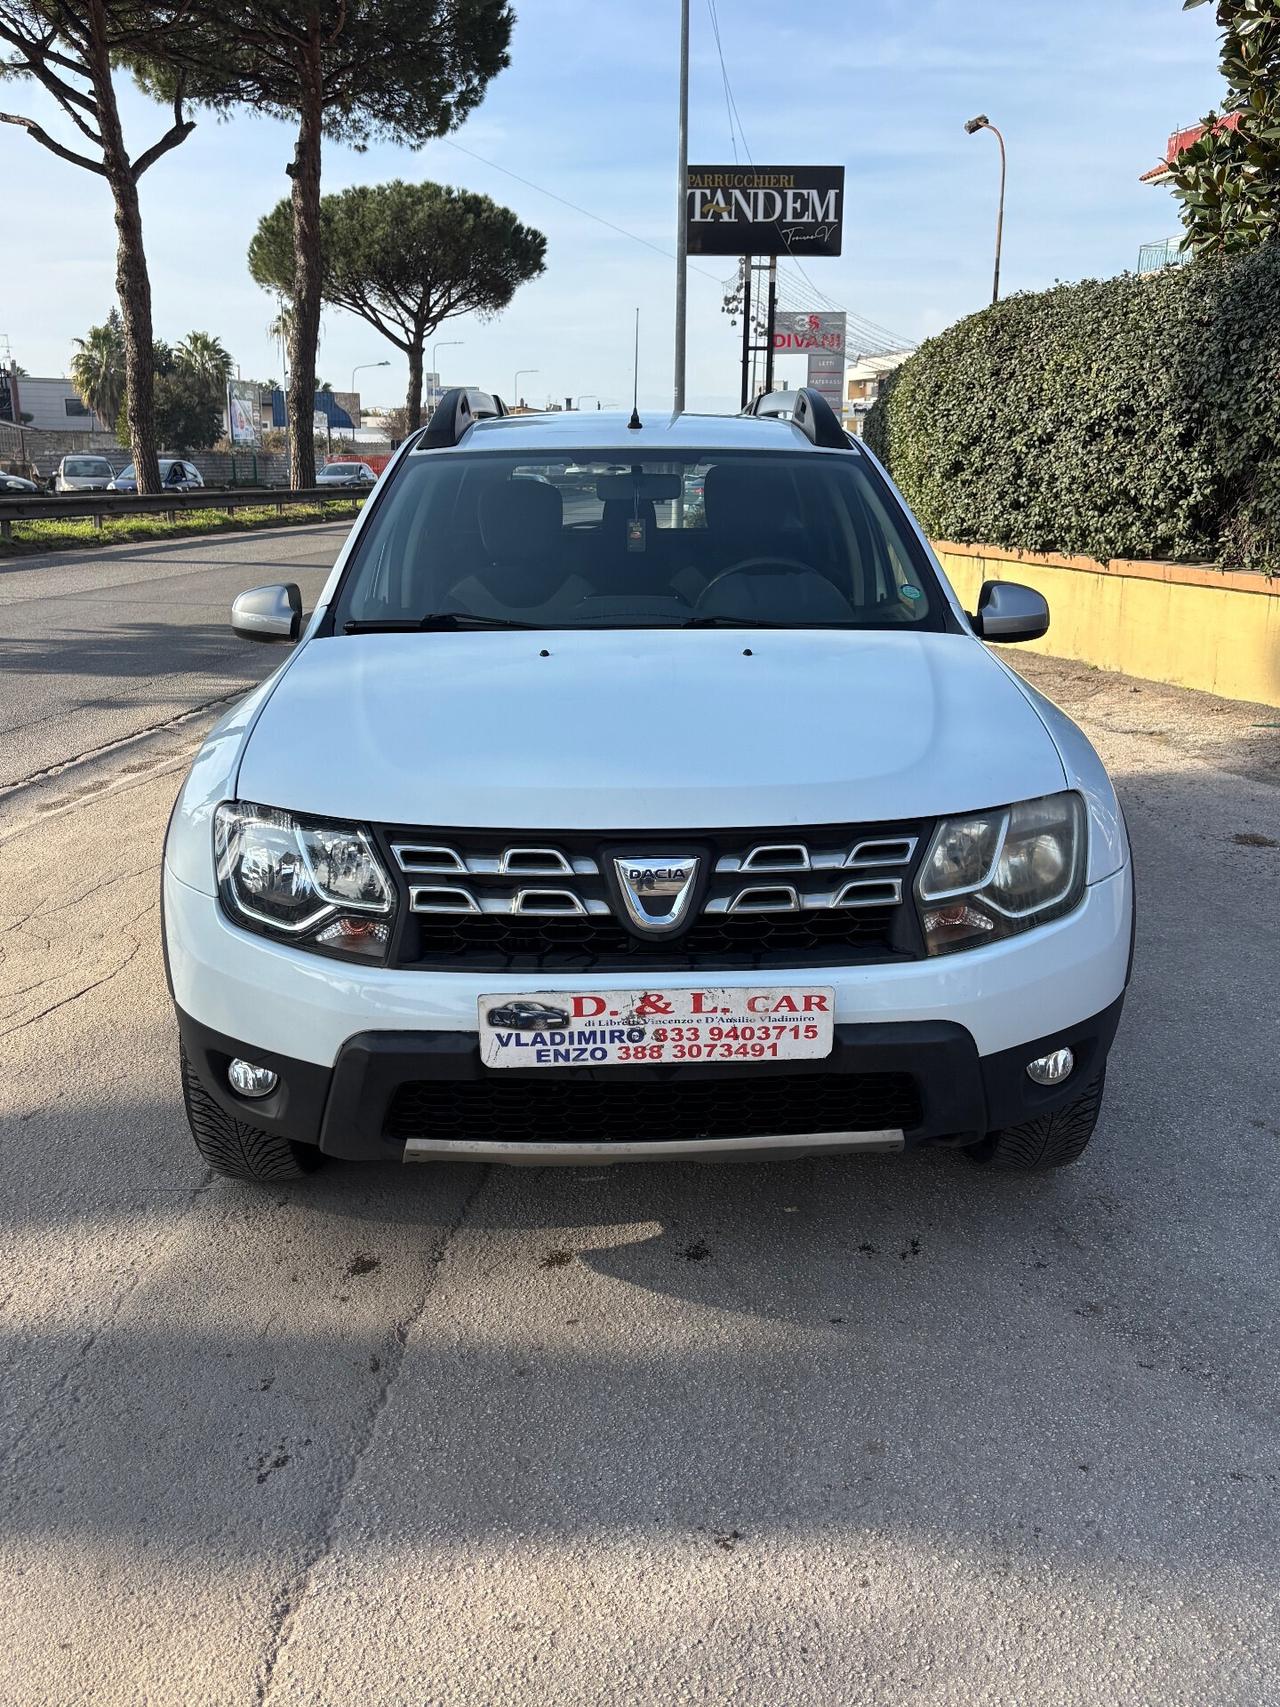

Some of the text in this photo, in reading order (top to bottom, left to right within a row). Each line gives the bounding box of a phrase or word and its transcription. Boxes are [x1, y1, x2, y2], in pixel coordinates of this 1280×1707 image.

[688, 174, 795, 187] PARRUCCHIERI
[687, 188, 840, 223] TANDEM
[773, 333, 841, 348] DIVANI
[629, 868, 686, 879] DACIA
[571, 992, 830, 1018] D. & L. CAR
[584, 1019, 595, 1027] di
[643, 1017, 693, 1025] Vincenzo
[760, 1015, 815, 1023] Vladimiro
[496, 1028, 645, 1047] VLADIMIRO
[709, 1024, 818, 1042] 9403715
[536, 1042, 779, 1063] ENZO 388 3073491
